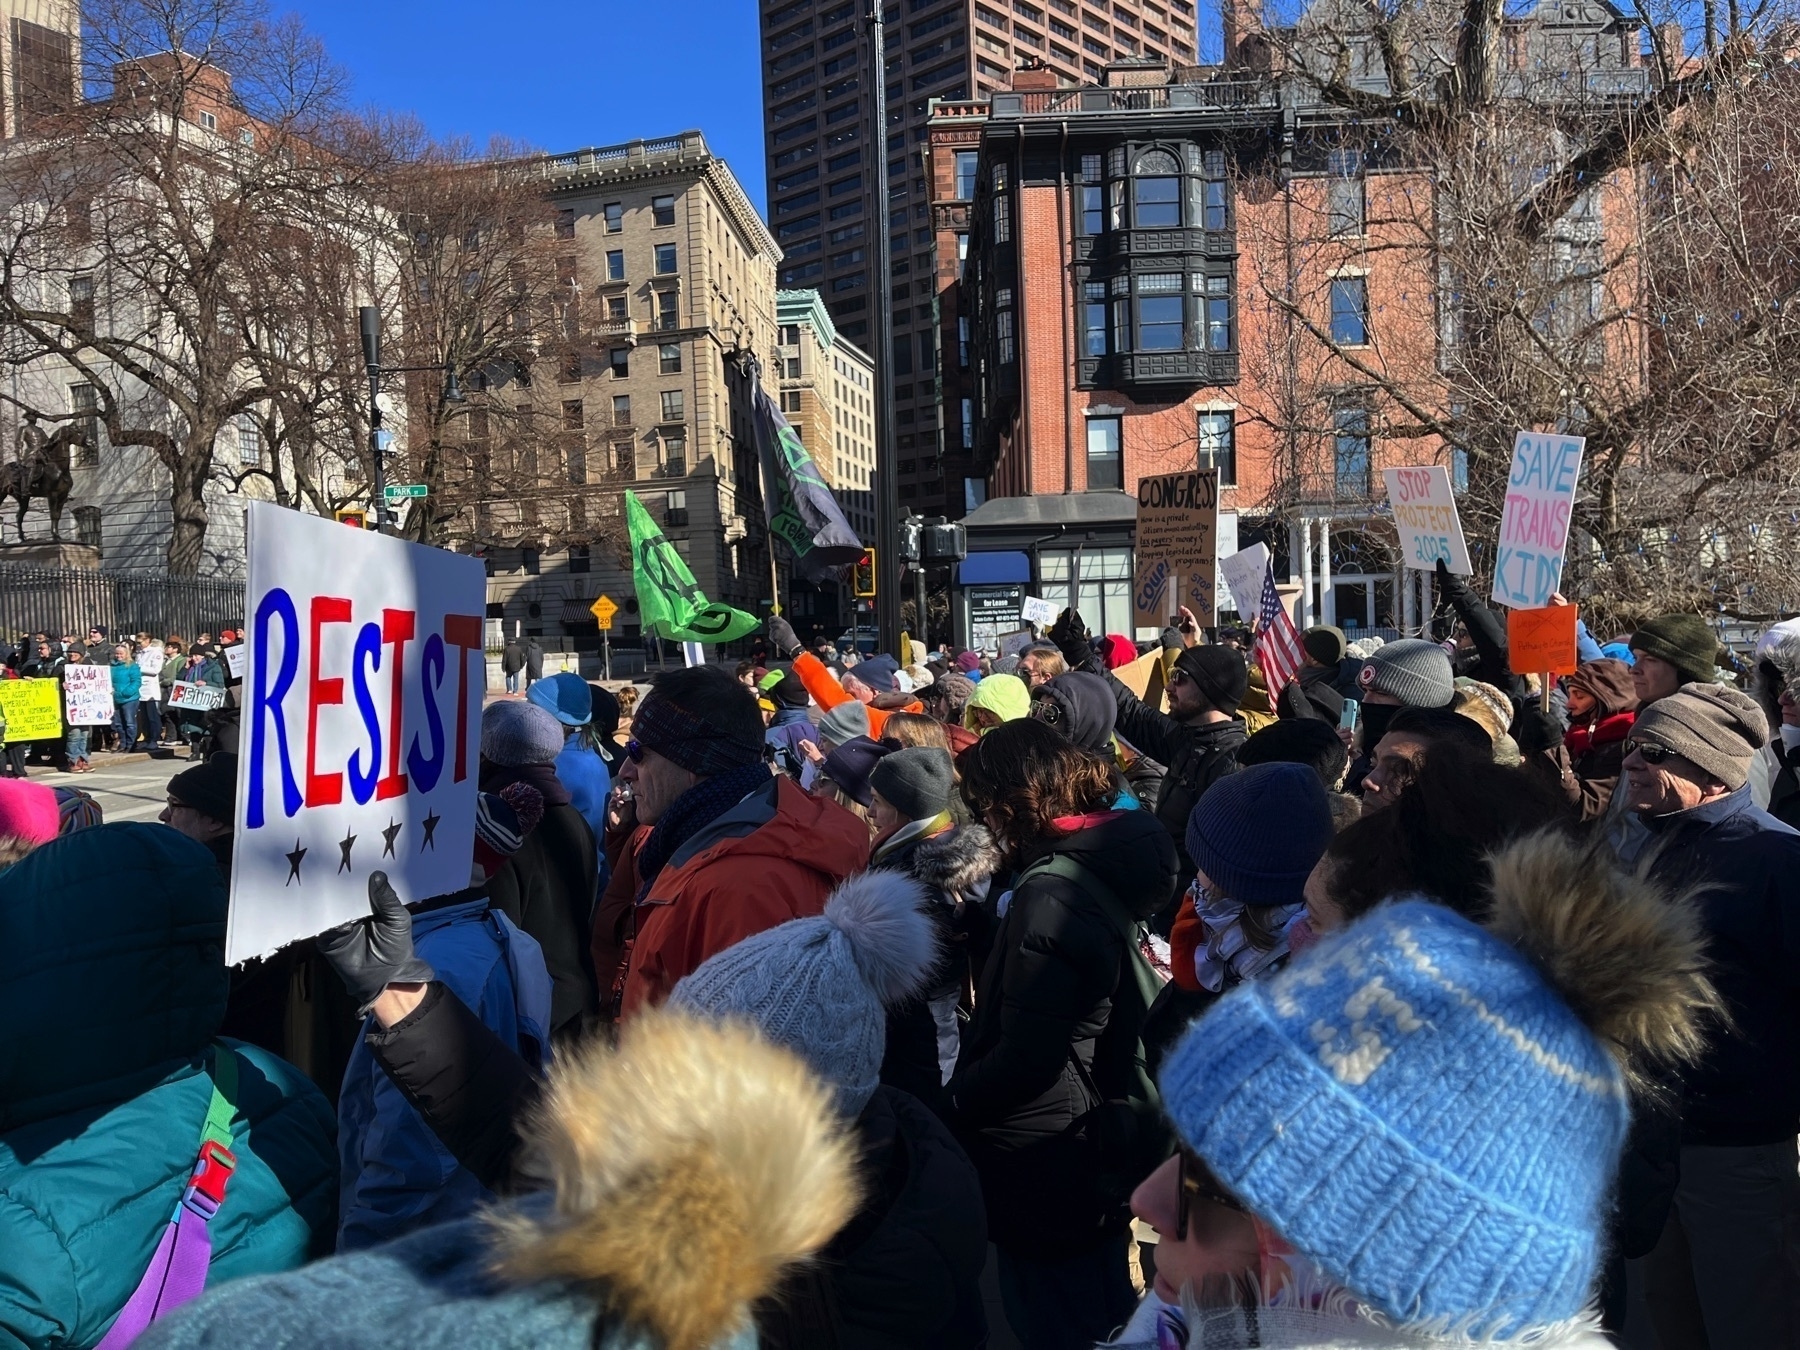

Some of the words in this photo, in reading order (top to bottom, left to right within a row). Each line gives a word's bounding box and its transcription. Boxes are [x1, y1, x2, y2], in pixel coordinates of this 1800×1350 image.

[1511, 438, 1579, 493] SAVE
[393, 487, 412, 496] PARK
[1138, 472, 1217, 510] CONGRESS
[1397, 469, 1431, 502] STOP
[1166, 512, 1190, 526] private
[1394, 504, 1453, 535] PROJECT
[1506, 494, 1570, 551] TRANS
[1142, 526, 1164, 535] citizen
[1175, 536, 1198, 546] money
[1137, 548, 1164, 560] stopping
[1165, 547, 1202, 559] legislated
[1413, 535, 1452, 566] 2025
[1174, 554, 1216, 569] programs?
[1136, 558, 1171, 610] COUP!
[1190, 572, 1212, 591] STOP
[1495, 546, 1562, 606] KIDS
[971, 591, 1003, 599] Commercial
[983, 599, 992, 607] for
[1190, 587, 1214, 616] DOGE!
[867, 600, 874, 610] 4
[1028, 600, 1049, 613] SAVE
[11, 690, 32, 699] ACCEPT
[35, 689, 41, 697] A
[246, 587, 483, 829] RESIST
